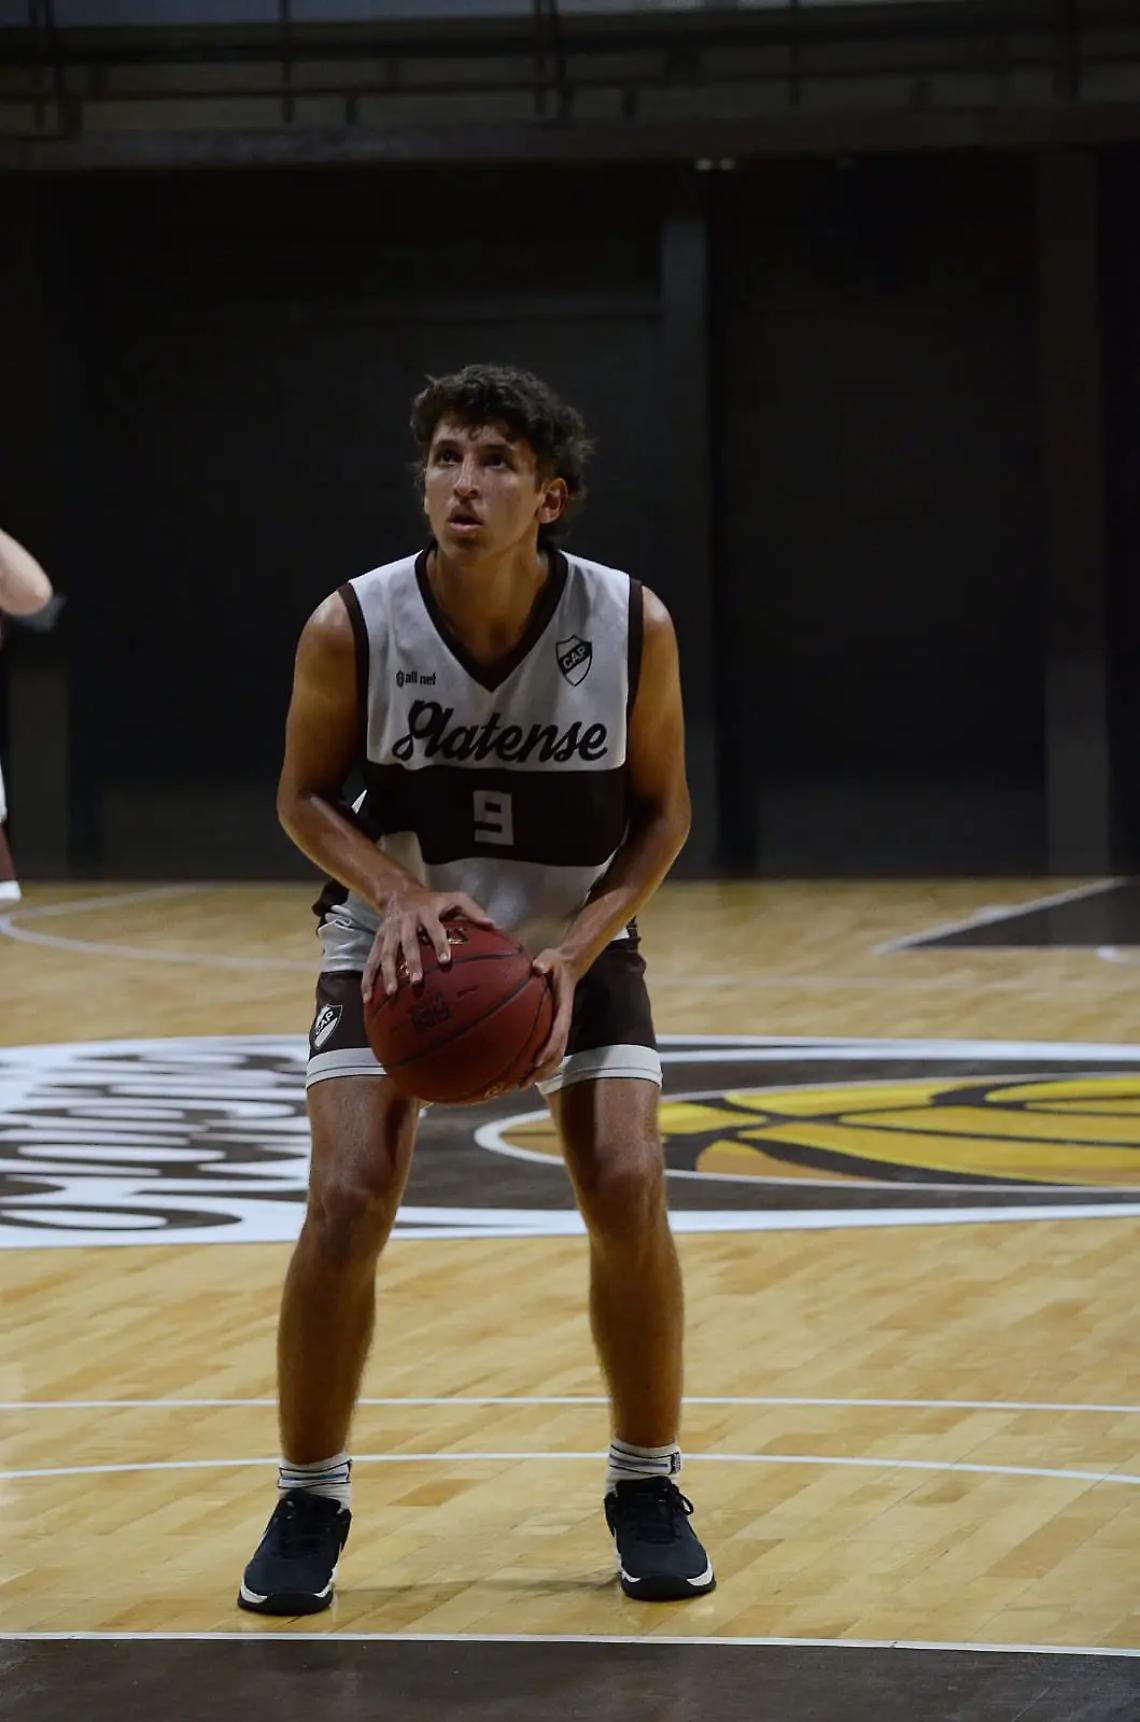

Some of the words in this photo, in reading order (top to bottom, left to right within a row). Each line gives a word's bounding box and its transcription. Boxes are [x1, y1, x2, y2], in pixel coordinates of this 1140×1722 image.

[562, 645, 586, 669] CAP
[420, 672, 437, 686] net
[392, 699, 607, 762] Platense
[473, 789, 514, 846] 9
